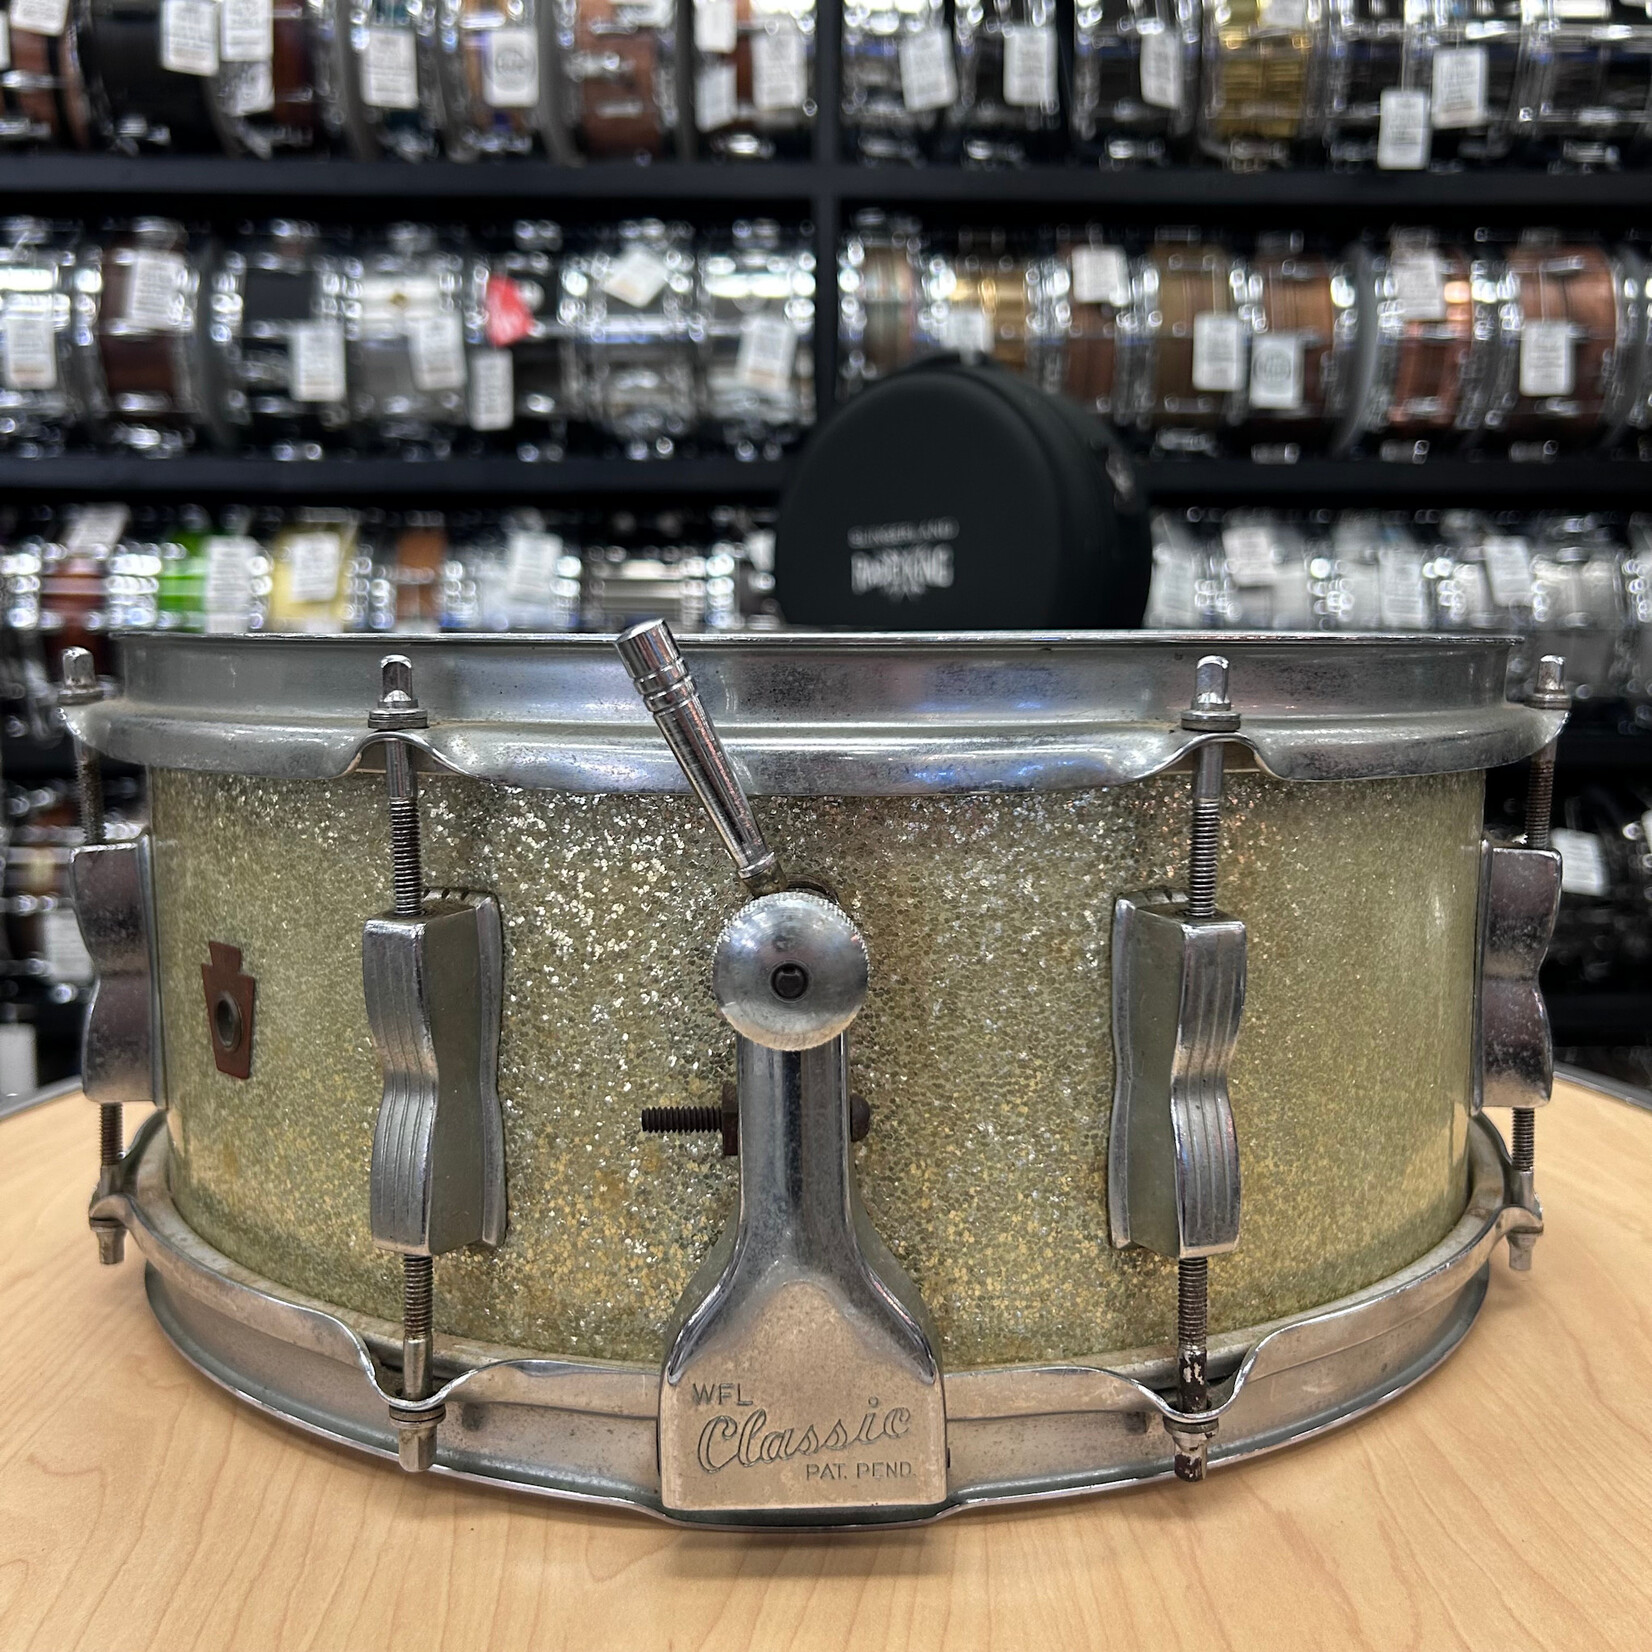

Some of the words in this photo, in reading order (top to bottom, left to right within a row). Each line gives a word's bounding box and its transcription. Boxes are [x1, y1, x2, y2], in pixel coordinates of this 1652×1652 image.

[692, 1382, 754, 1407] WFL
[697, 1396, 911, 1474] Classic
[806, 1462, 847, 1481] PAT.
